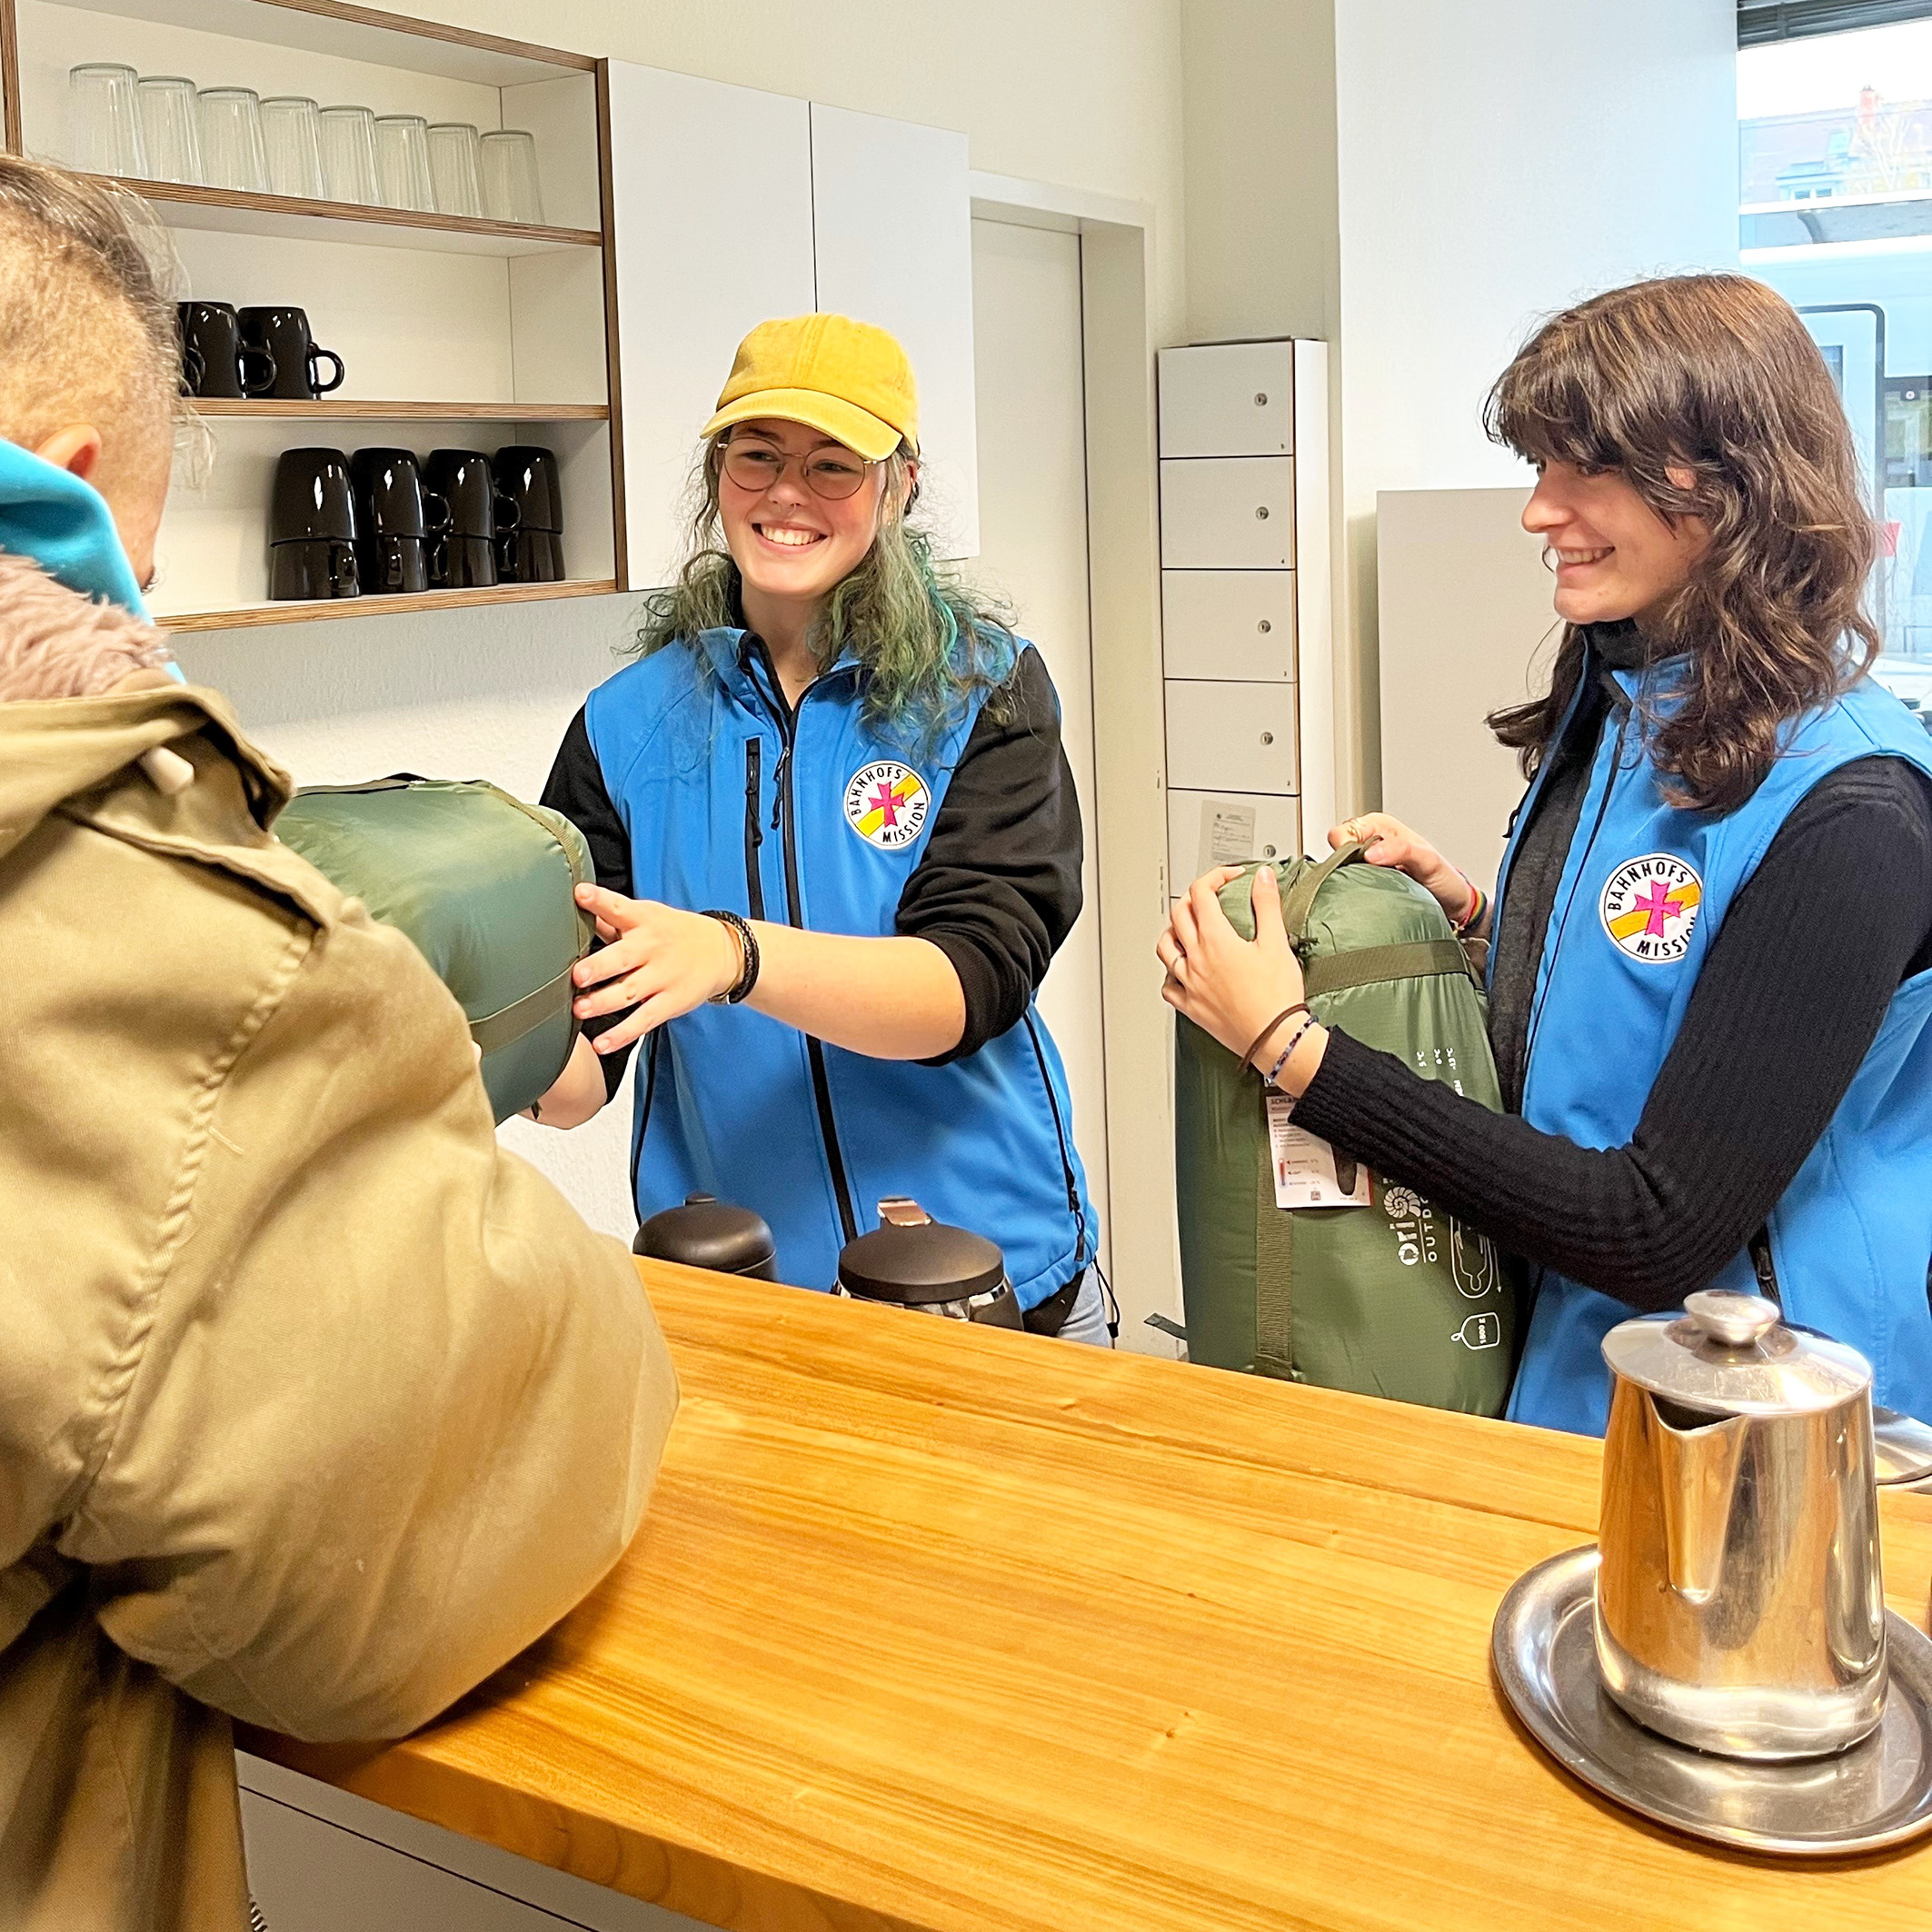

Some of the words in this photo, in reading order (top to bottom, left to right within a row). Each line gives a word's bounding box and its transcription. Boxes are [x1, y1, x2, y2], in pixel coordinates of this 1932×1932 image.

[849, 767, 902, 816] BAHNHOFS
[882, 802, 925, 842] MISSION
[1608, 861, 1688, 911] BAHNHOFS
